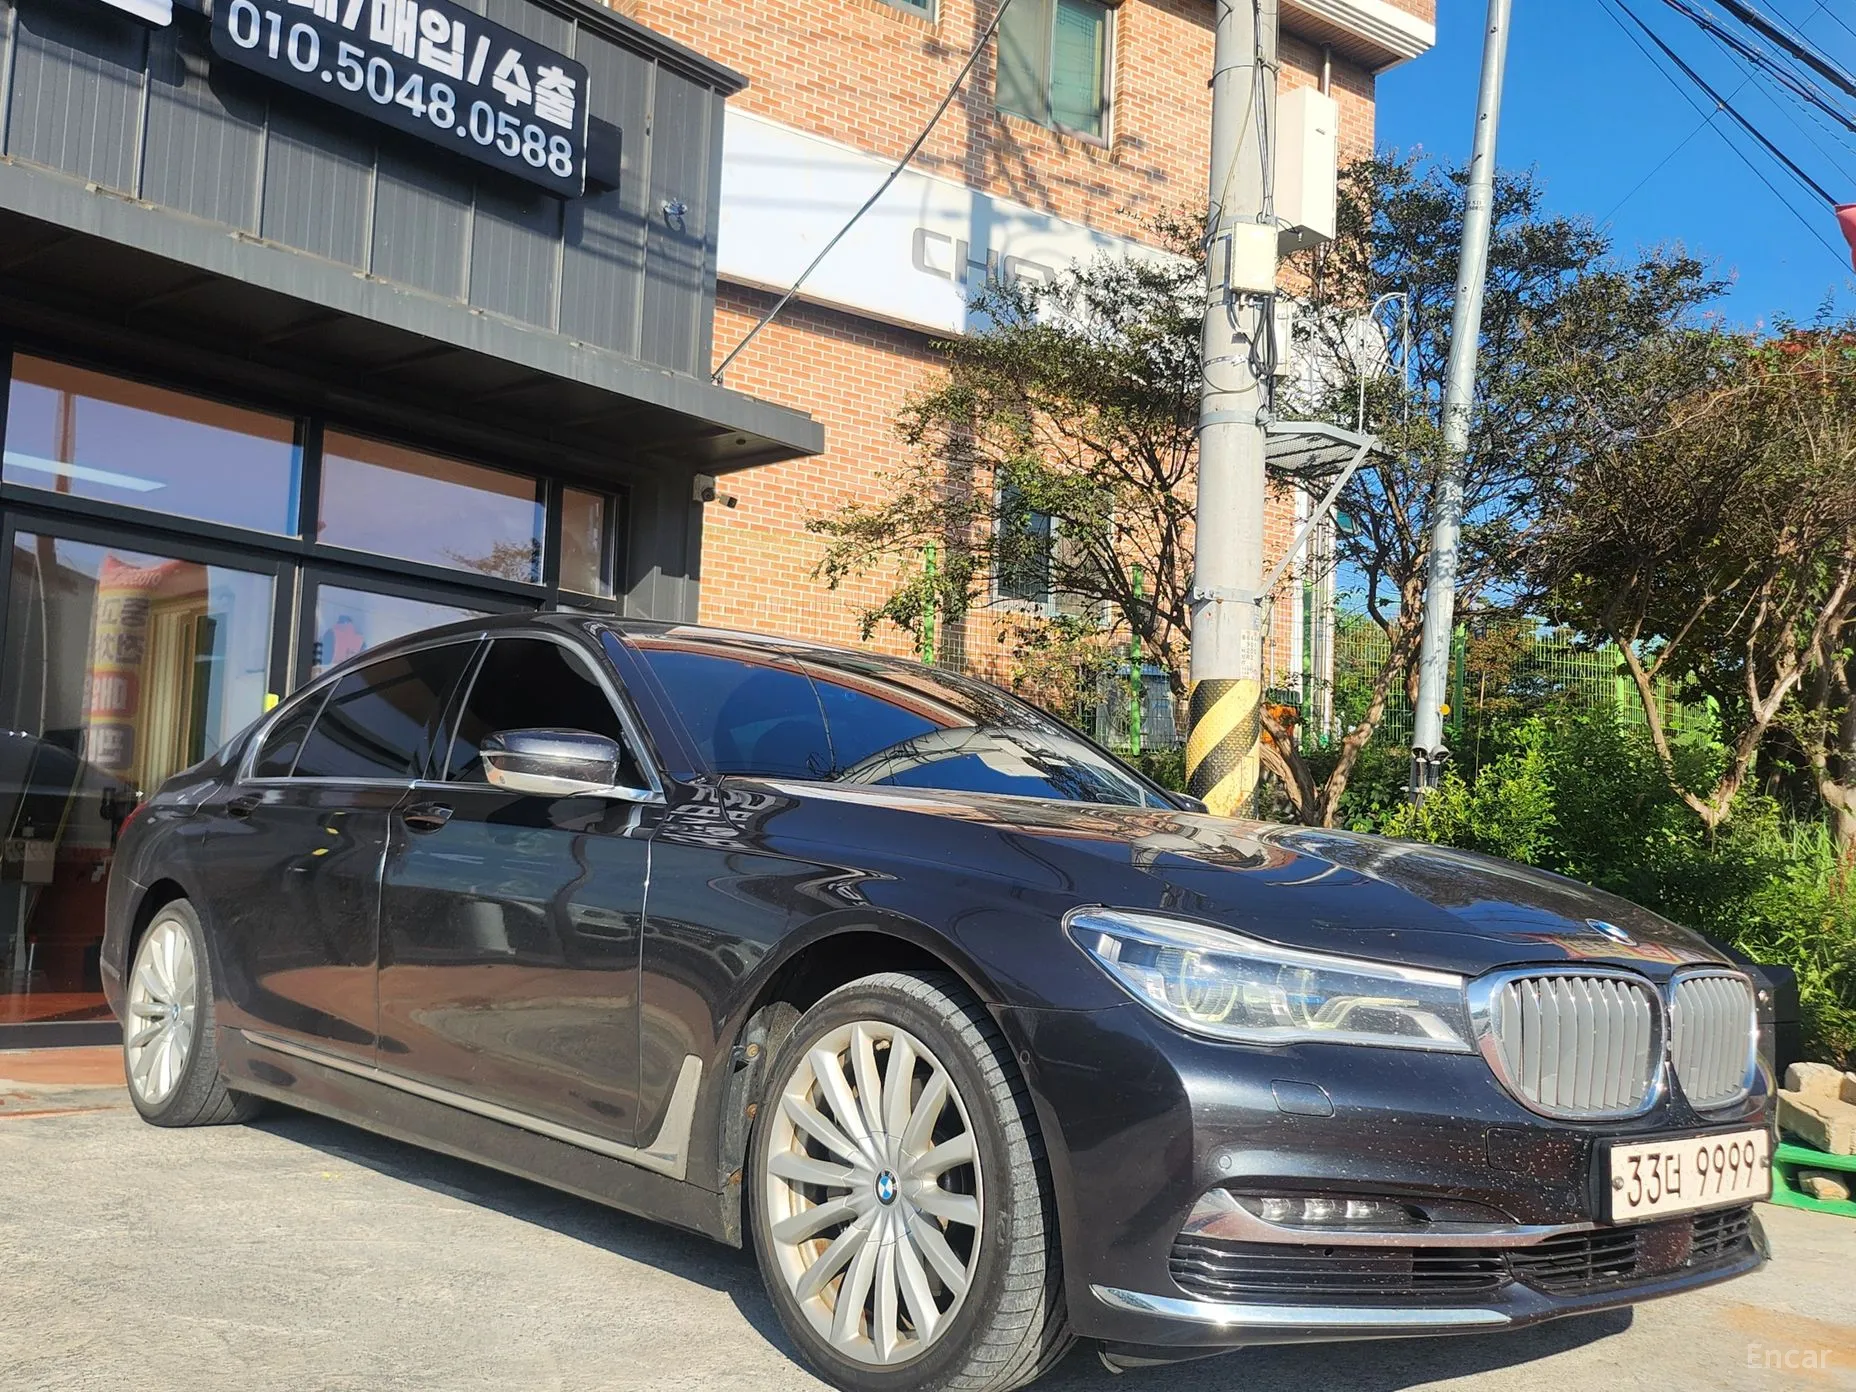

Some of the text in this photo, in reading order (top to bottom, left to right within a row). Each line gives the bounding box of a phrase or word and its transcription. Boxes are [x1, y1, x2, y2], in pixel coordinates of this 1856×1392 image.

[228, 0, 574, 178] 010.5048.0588
[1627, 1139, 1755, 1207] 33더 9999
